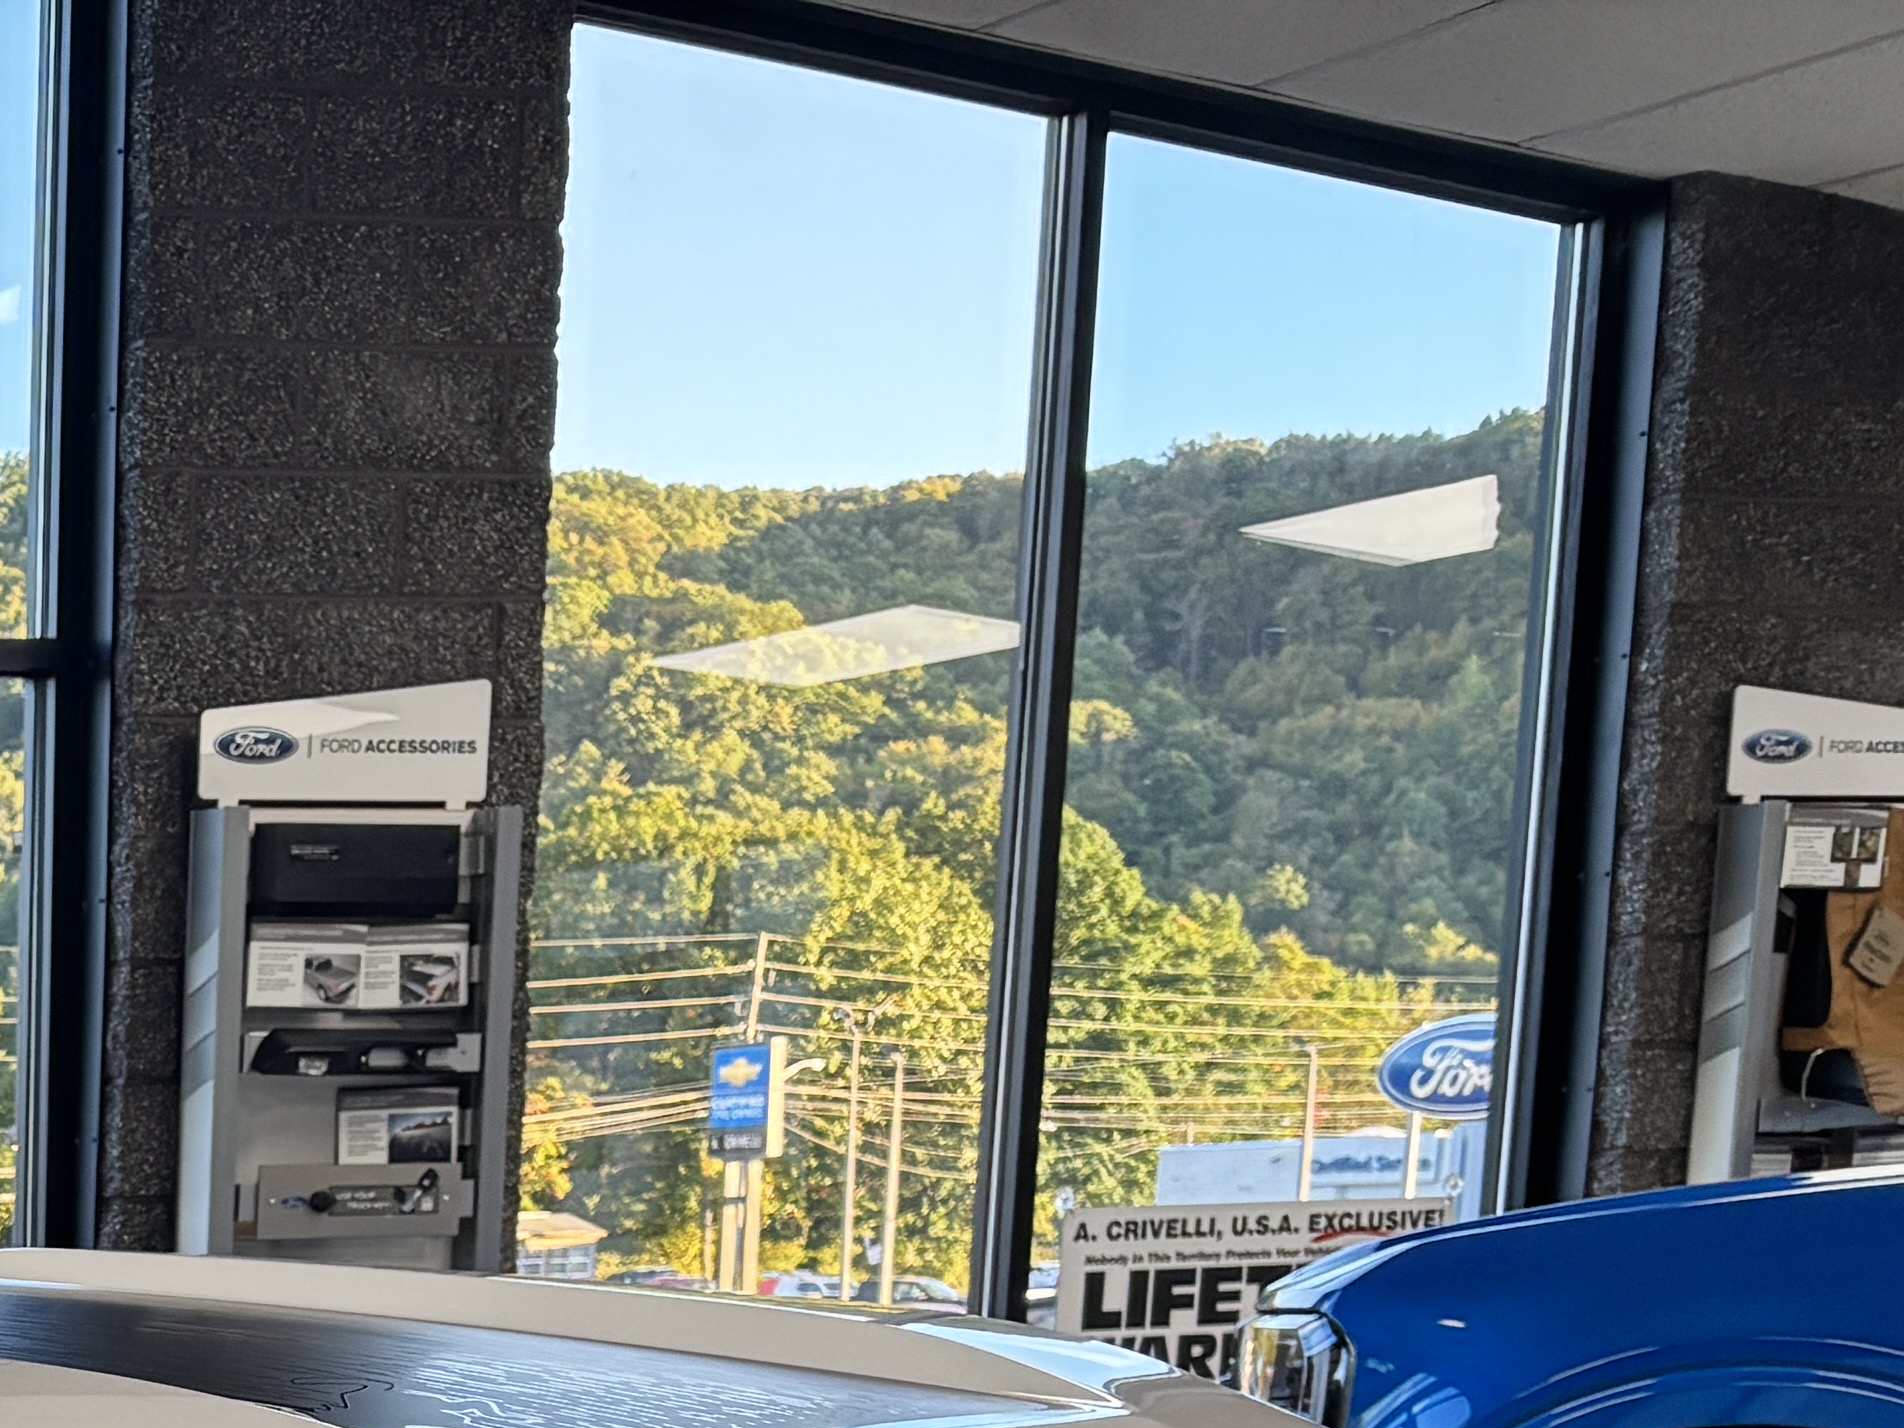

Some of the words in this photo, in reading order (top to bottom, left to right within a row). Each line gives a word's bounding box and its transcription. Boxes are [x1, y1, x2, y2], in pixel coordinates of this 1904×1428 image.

[319, 739, 362, 754] FORD
[365, 738, 478, 755] ACCESSORIES
[1830, 740, 1863, 754] FORD
[1074, 1222, 1098, 1243] A.
[1106, 1217, 1223, 1242] CRIVELLI,
[1232, 1214, 1300, 1237] U.S.A.
[1308, 1208, 1445, 1234] EXCLUSIVE!
[1084, 1253, 1128, 1267] Nobody
[1081, 1263, 1293, 1330] LIFET
